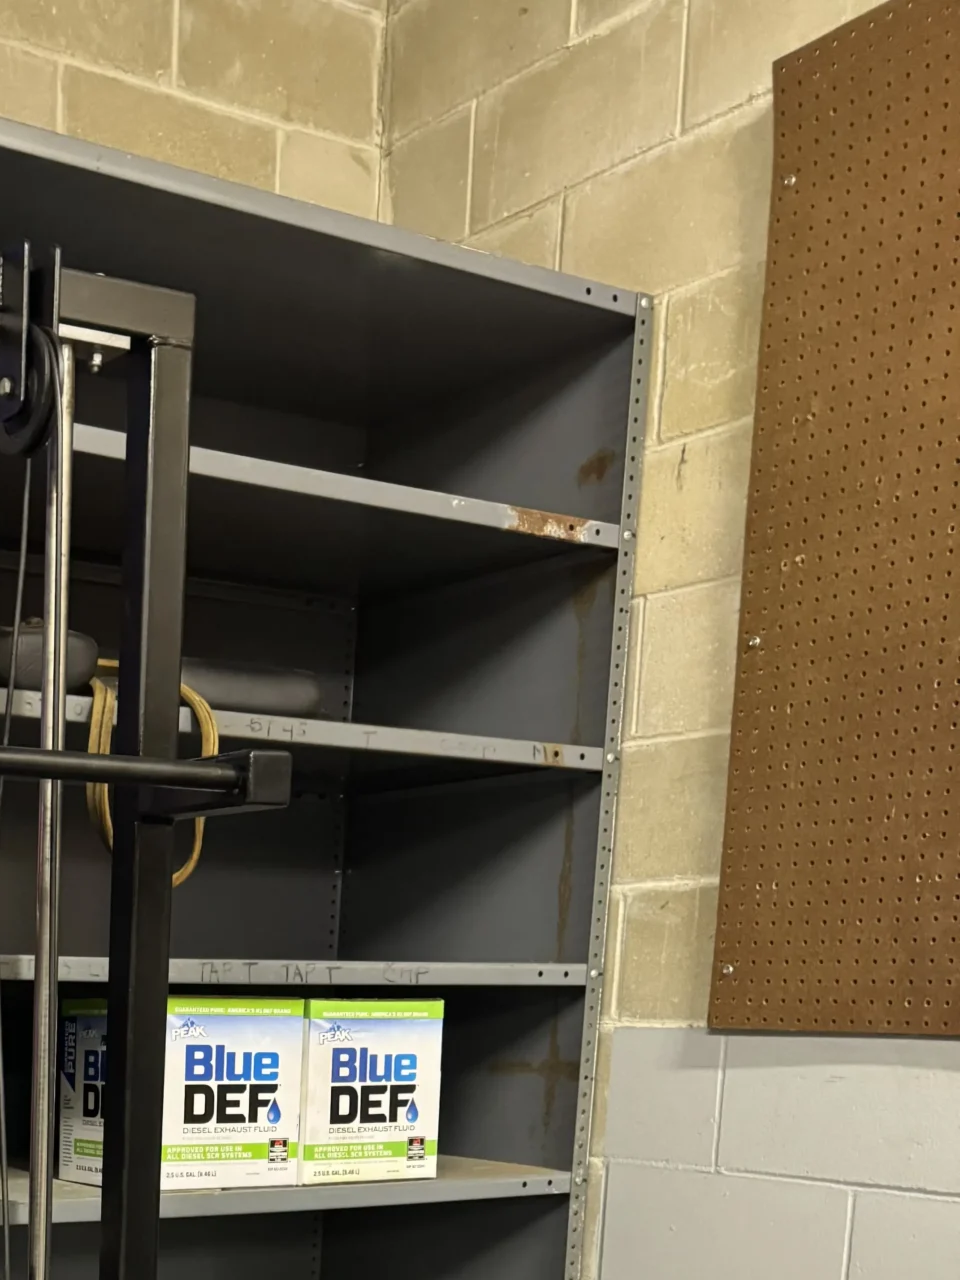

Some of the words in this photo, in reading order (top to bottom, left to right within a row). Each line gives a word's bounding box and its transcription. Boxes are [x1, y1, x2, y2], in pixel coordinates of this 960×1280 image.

[171, 1025, 208, 1040] PEAK
[319, 1029, 353, 1045] PEAK
[185, 1044, 279, 1081] Blue
[331, 1047, 417, 1082] Blue
[183, 1084, 278, 1124] DEF
[330, 1084, 416, 1124] DEF
[214, 1126, 252, 1134] EXHAUST
[222, 1151, 252, 1159] SYSTEMS
[314, 1145, 348, 1153] APPROVED
[364, 1150, 392, 1158] SYSTEMS
